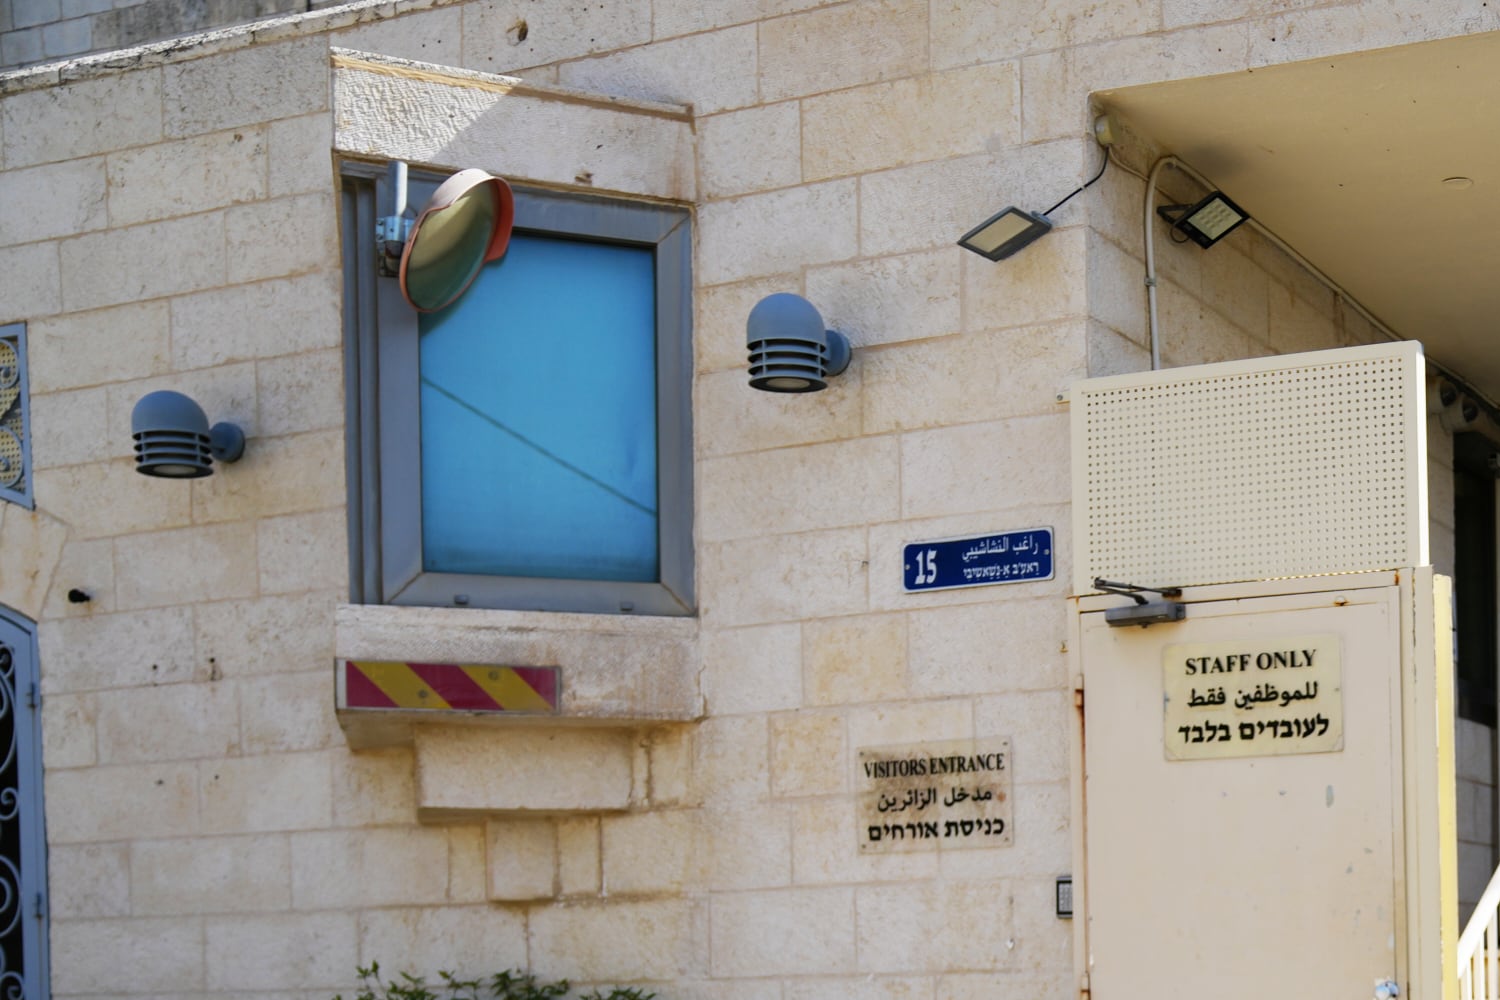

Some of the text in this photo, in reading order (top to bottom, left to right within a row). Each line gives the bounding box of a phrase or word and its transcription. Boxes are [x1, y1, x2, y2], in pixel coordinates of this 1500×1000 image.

[1012, 534, 1039, 555] راغب
[915, 549, 937, 585] 15
[1185, 649, 1316, 675] STAFF ONLY
[1187, 681, 1318, 710] للموظفين فقط
[1178, 713, 1329, 743] לעובדים בלבד
[864, 753, 1005, 778] VISITORS ENTRANCE
[878, 787, 993, 812] مدخل الزائرين
[868, 818, 1005, 841] כניסת אורחים
